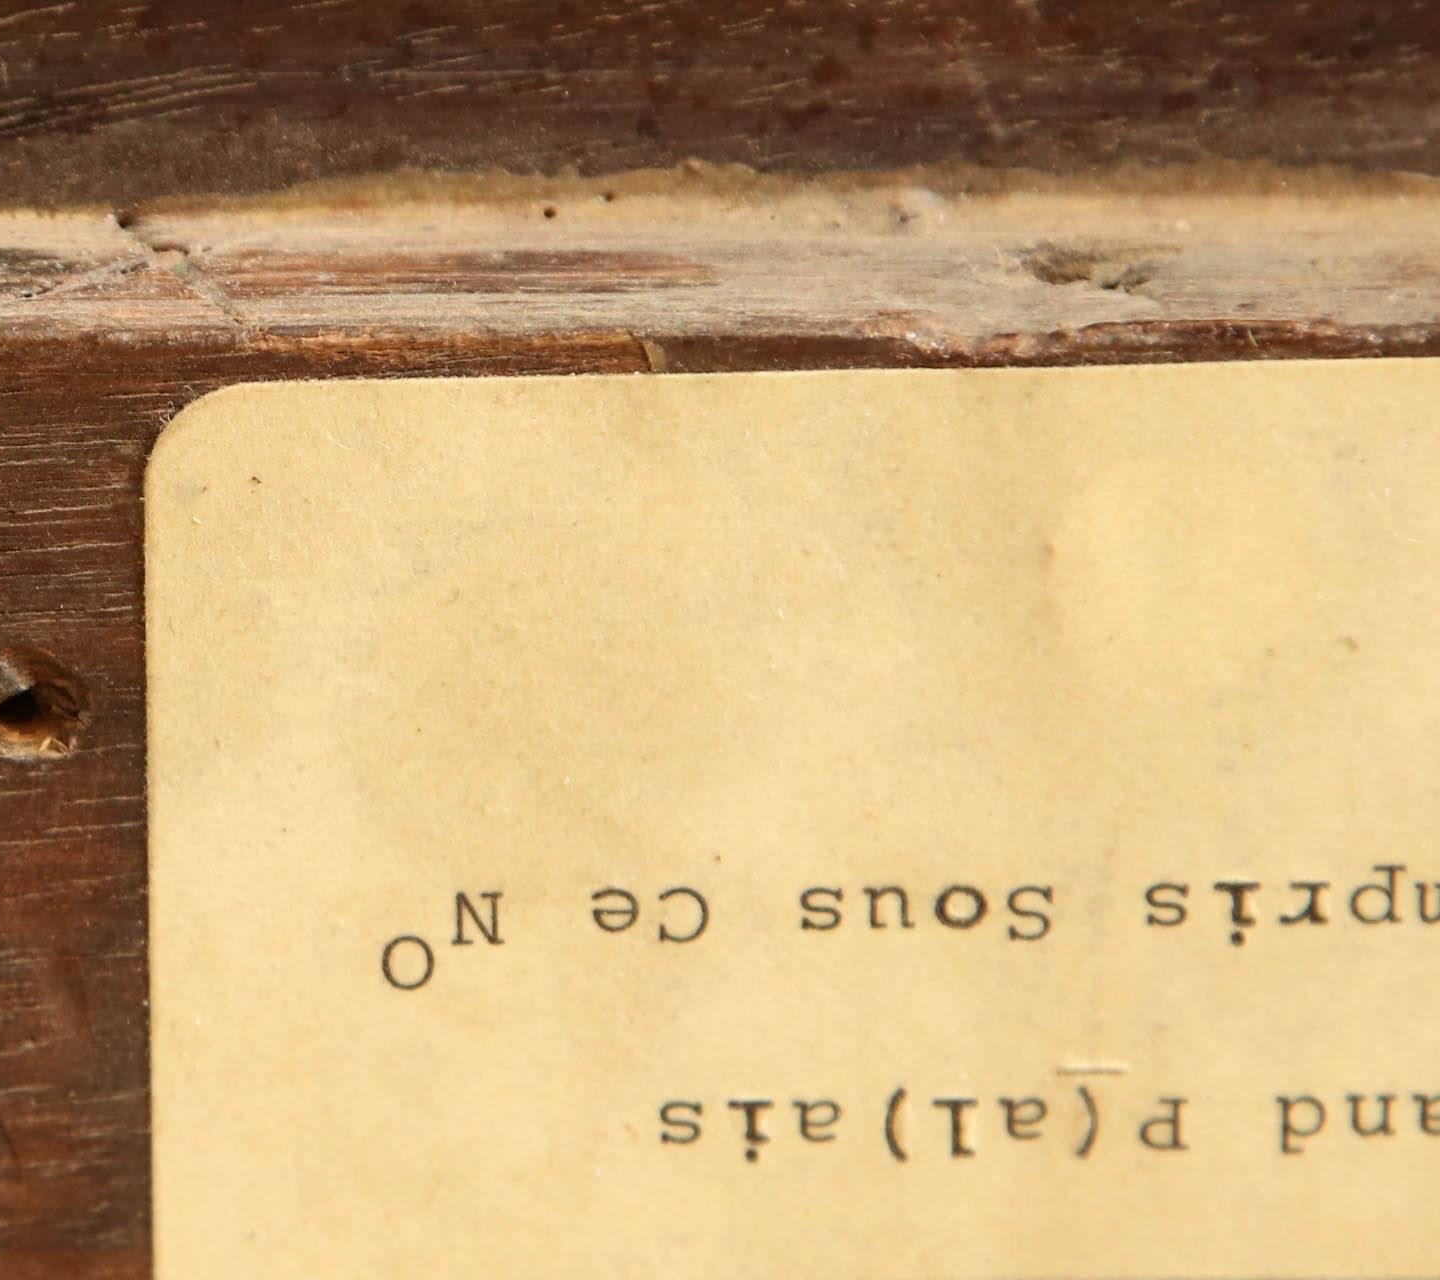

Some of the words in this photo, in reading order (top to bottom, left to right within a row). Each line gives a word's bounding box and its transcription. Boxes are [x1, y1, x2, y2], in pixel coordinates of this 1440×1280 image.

[589, 888, 711, 945] Ce
[797, 884, 1055, 942] Sous
[656, 1086, 1190, 1165] P(al)ais
